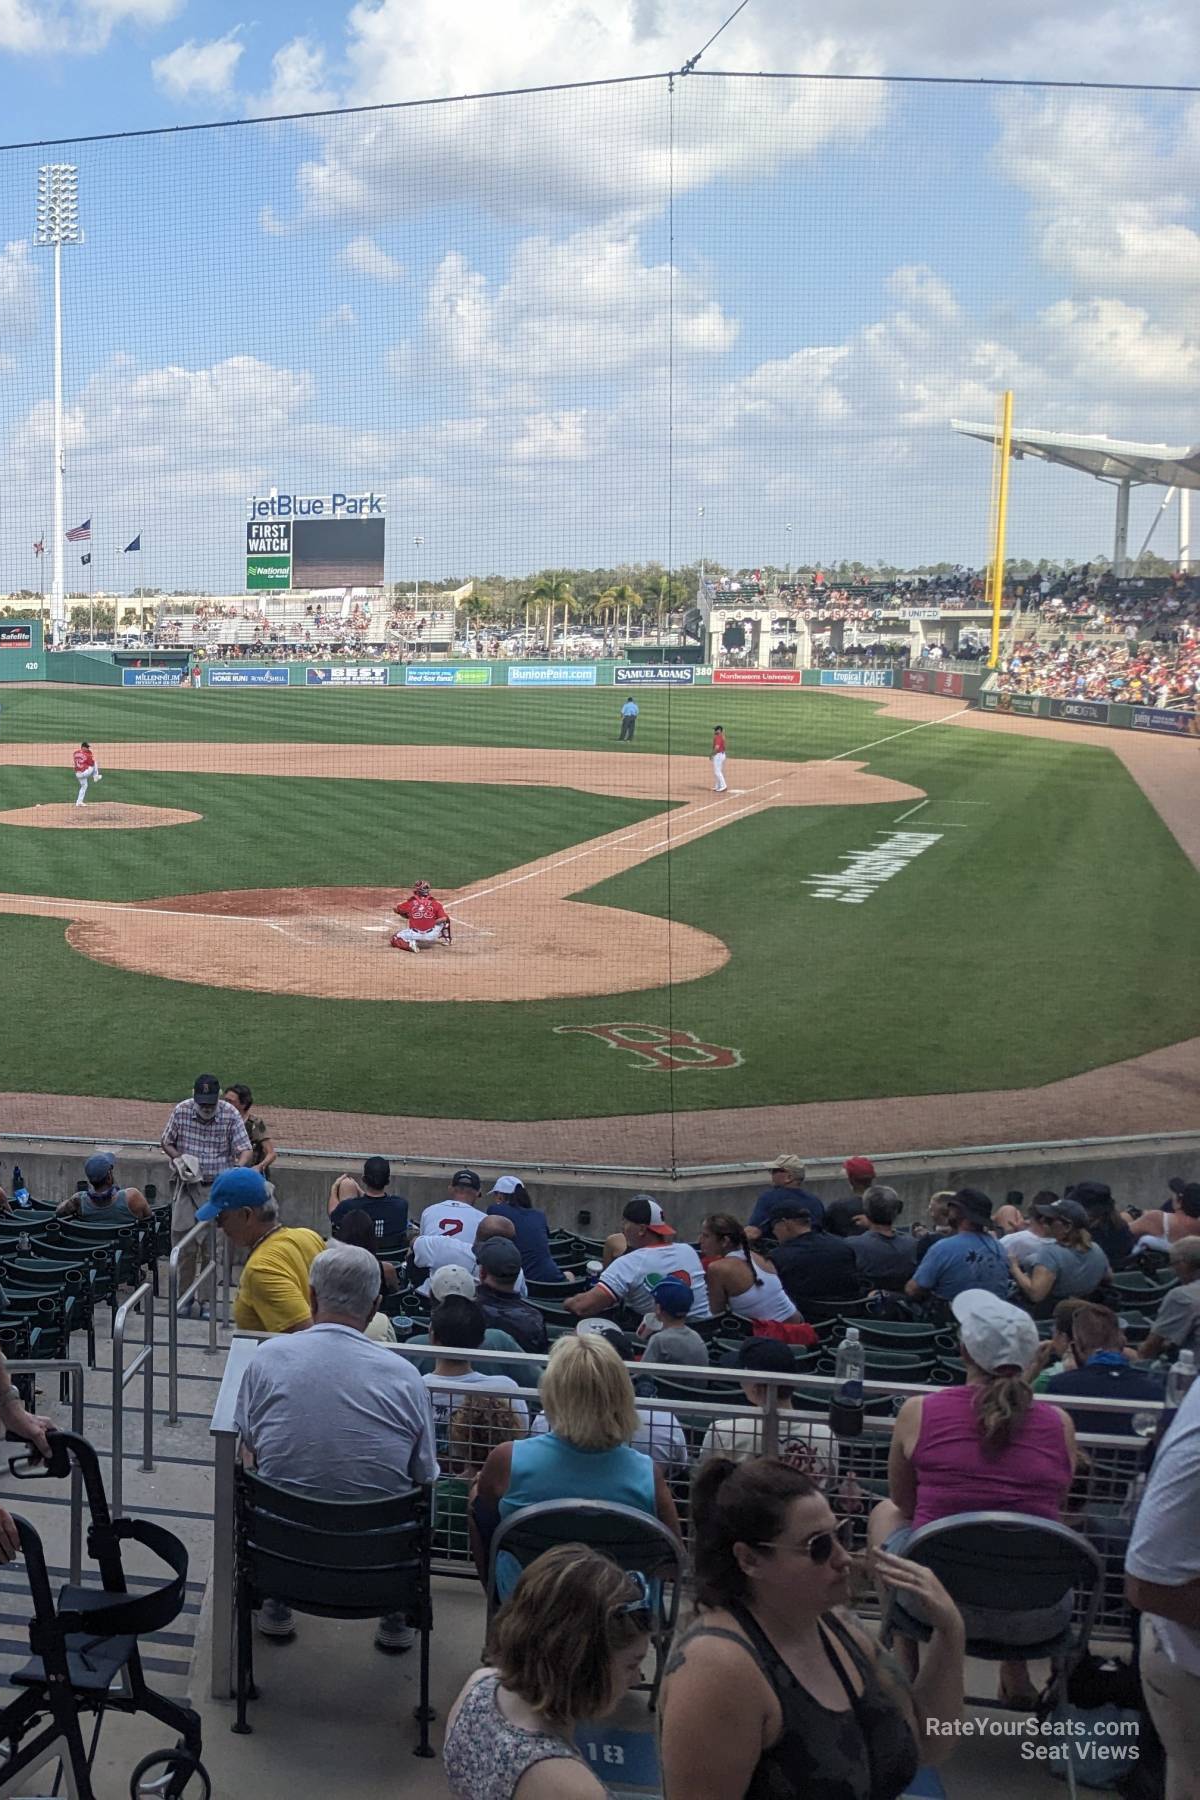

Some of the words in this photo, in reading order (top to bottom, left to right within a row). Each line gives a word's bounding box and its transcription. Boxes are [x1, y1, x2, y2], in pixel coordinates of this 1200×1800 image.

[250, 494, 323, 520] jetBlue
[332, 492, 382, 514] Park
[252, 524, 286, 538] FIRST
[248, 538, 289, 552] WATCH
[256, 566, 290, 576] National
[735, 611, 742, 619] 4
[908, 610, 938, 618] UNITED
[25, 662, 38, 670] 420
[695, 667, 711, 676] 380
[330, 668, 385, 677] BEST
[512, 668, 592, 680] BunionPain.com
[617, 668, 655, 679] SAMUEL
[657, 668, 691, 680] ADAMS
[719, 672, 761, 680] Northeastern
[762, 673, 795, 682] University
[833, 671, 861, 682] tropical
[863, 671, 886, 686] CAFE
[438, 1218, 464, 1237] 2
[587, 1742, 625, 1766] 18
